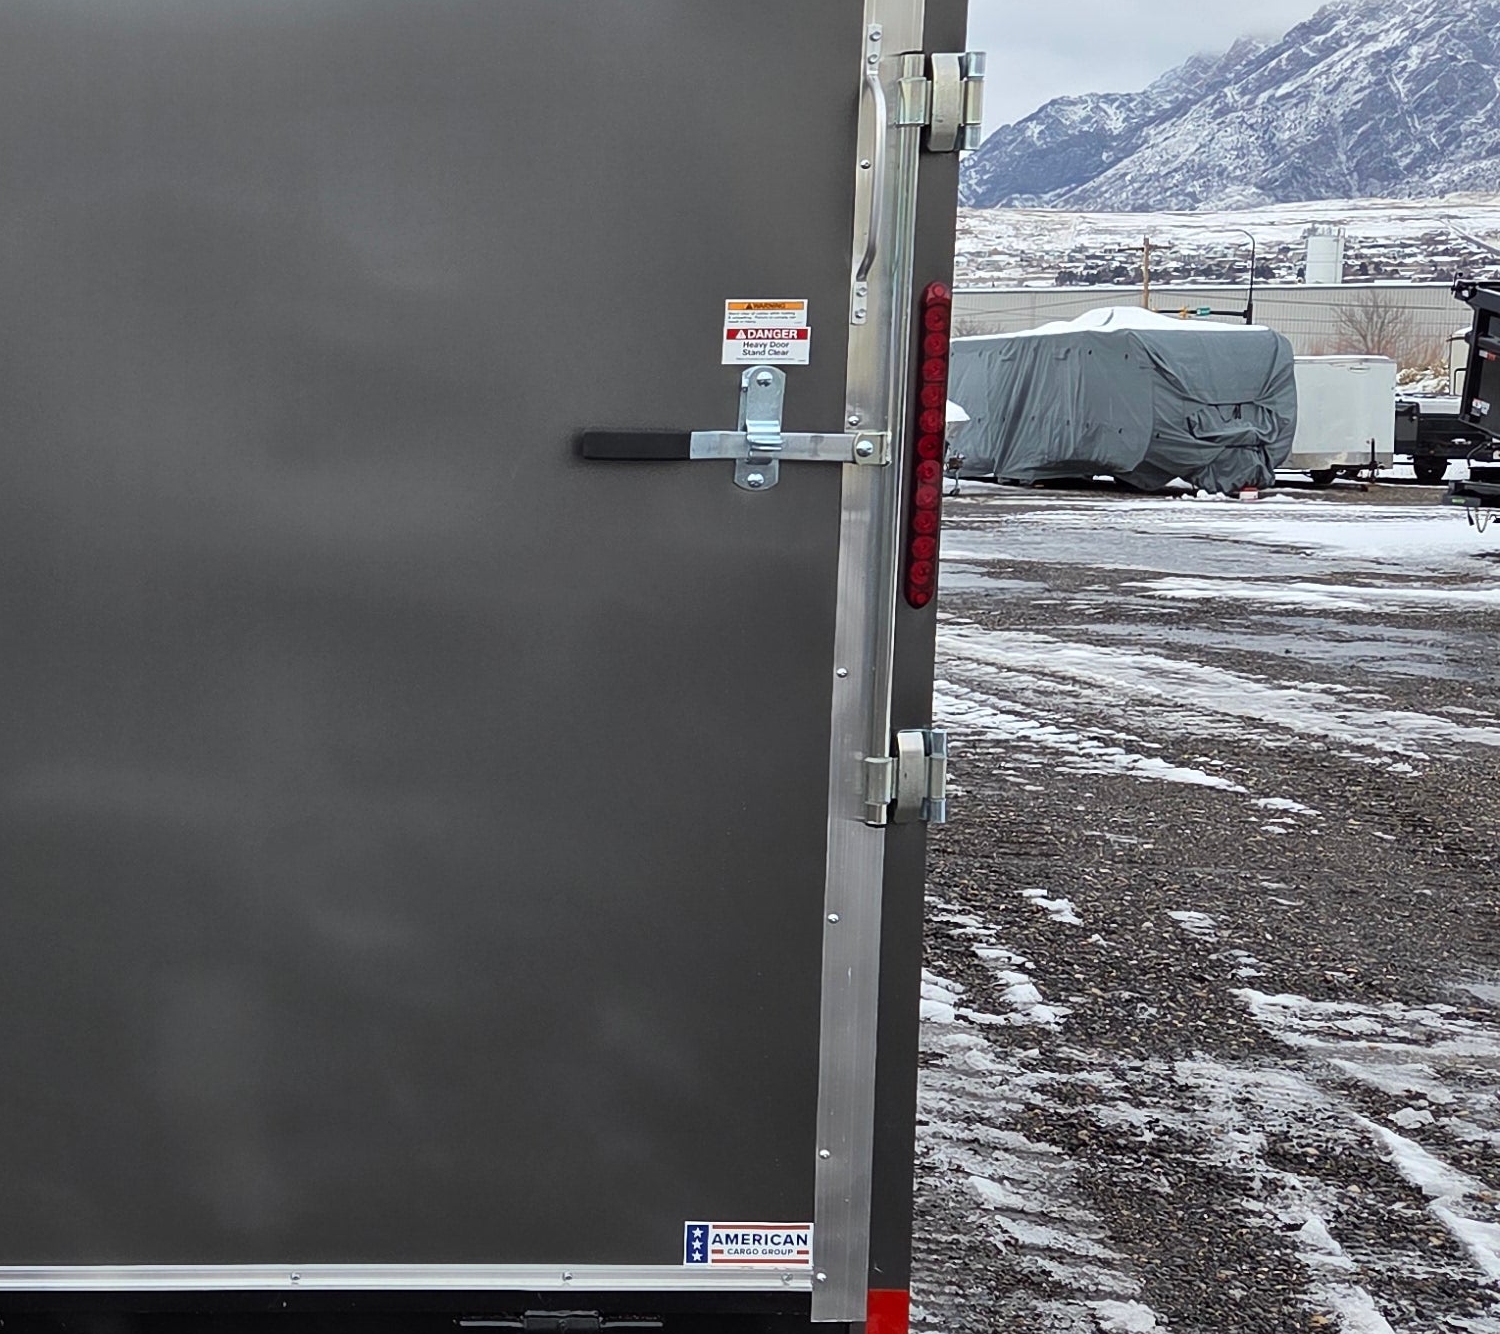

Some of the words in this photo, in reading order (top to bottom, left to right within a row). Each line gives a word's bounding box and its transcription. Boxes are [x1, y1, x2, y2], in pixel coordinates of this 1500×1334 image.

[747, 329, 798, 339] DANGER
[743, 341, 768, 349] Heavy
[711, 1233, 808, 1246] AMERICAN
[761, 1248, 794, 1256] GROUP
